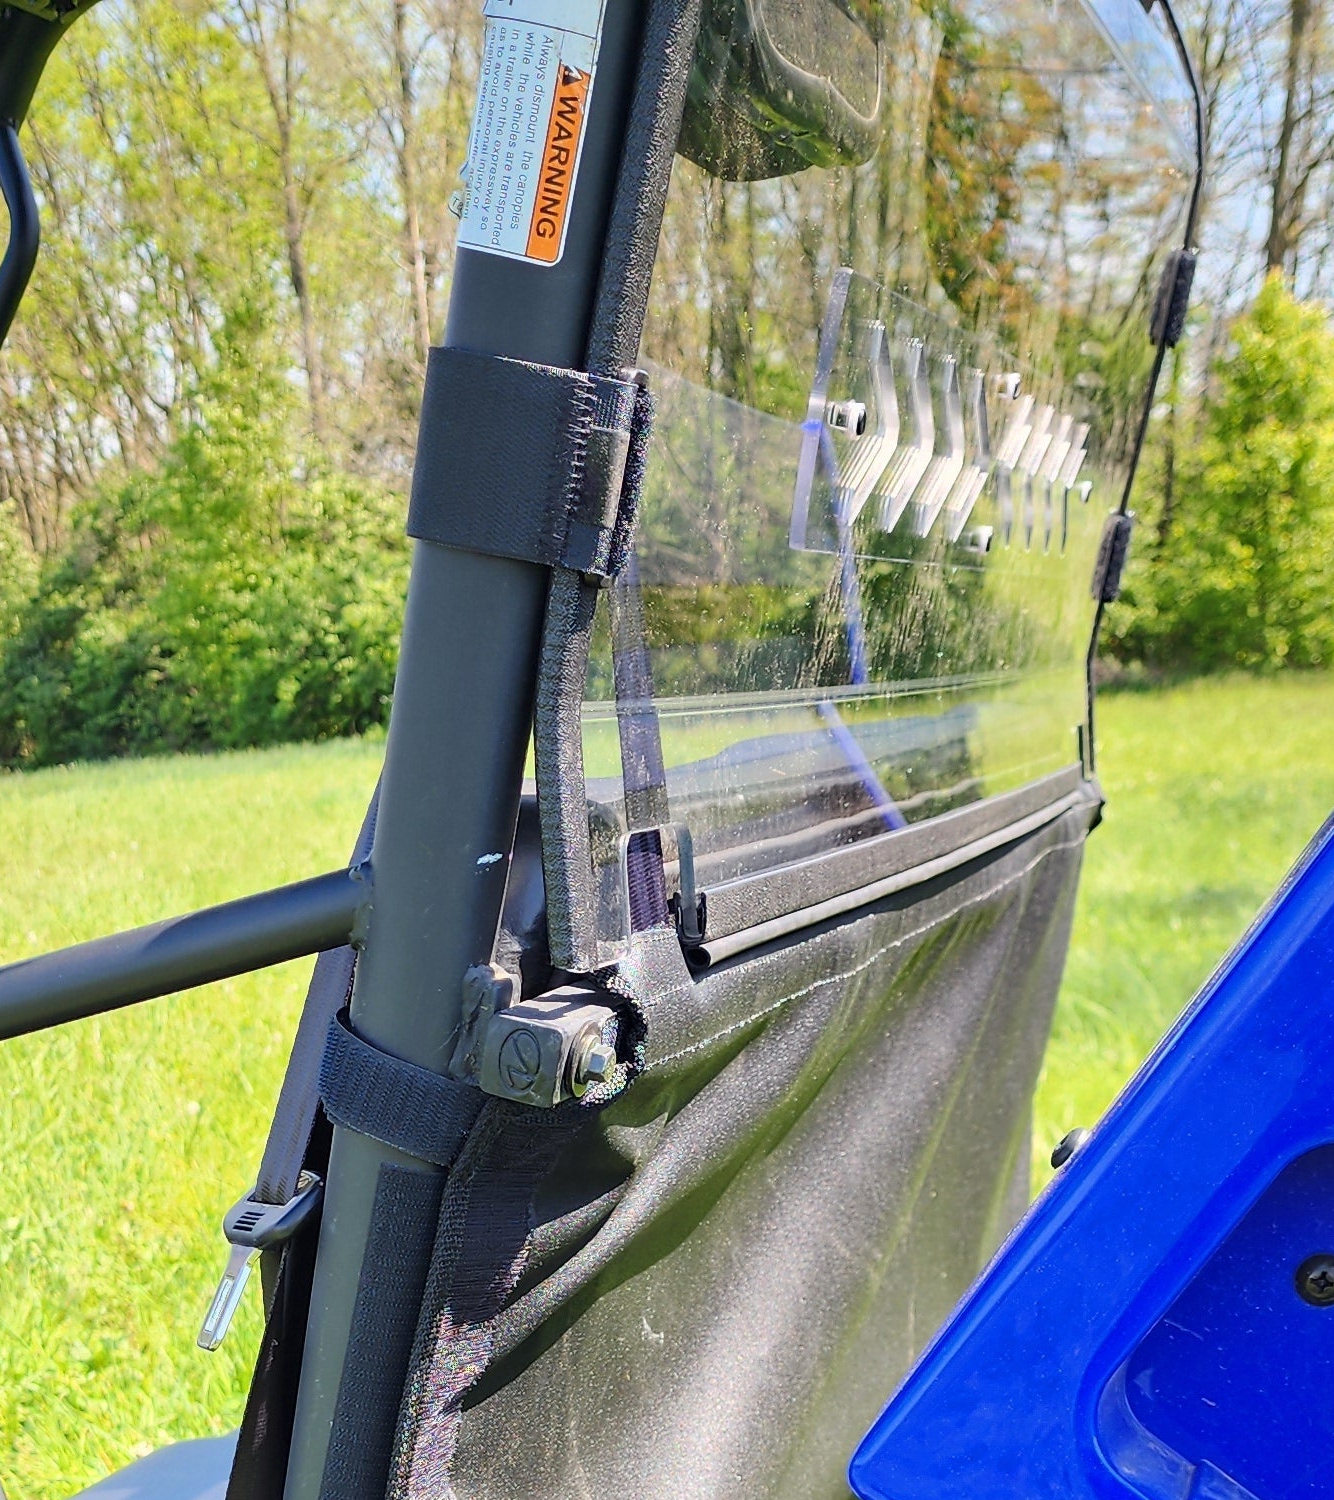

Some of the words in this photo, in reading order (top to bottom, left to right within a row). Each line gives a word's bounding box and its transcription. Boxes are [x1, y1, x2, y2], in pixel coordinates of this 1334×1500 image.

[496, 45, 505, 58] to
[498, 26, 507, 42] as
[521, 30, 537, 66] while
[502, 56, 516, 93] trailer
[533, 33, 554, 81] Always
[490, 61, 502, 96] avoid
[517, 72, 529, 93] the
[499, 96, 508, 112] on
[507, 95, 525, 148] vehicles
[525, 83, 545, 144] dismount
[481, 100, 496, 155] personal
[496, 116, 506, 136] the
[474, 158, 486, 193] injury
[481, 138, 501, 213] expressway
[504, 151, 515, 172] are
[520, 149, 533, 171] the
[534, 92, 579, 241] WARNING
[472, 196, 480, 208] or
[490, 174, 511, 246] transported
[508, 172, 528, 230] canopies
[480, 215, 489, 231] so
